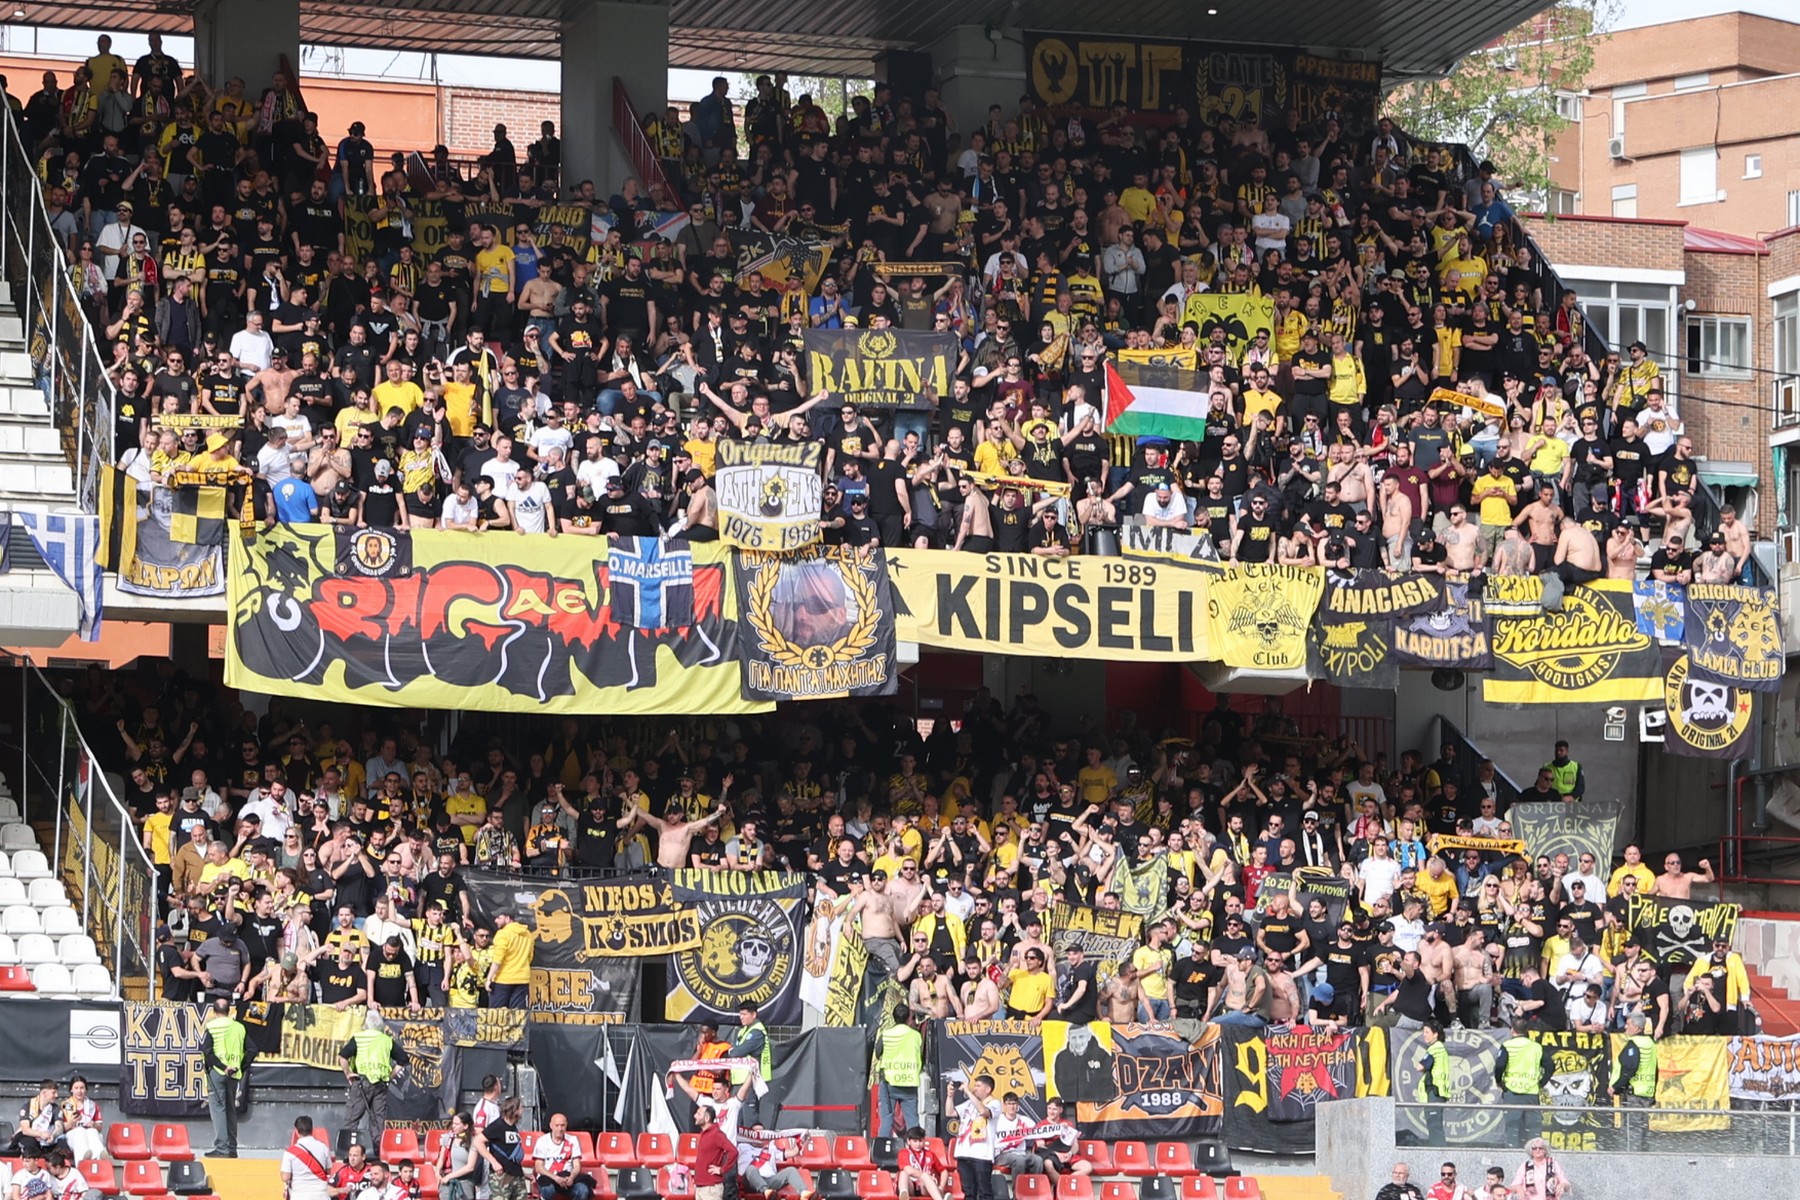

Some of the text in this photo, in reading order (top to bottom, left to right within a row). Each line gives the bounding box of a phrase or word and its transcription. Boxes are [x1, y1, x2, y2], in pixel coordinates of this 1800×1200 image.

[810, 350, 948, 397] RAFINA
[844, 392, 915, 405] ORIGINAL 21
[718, 437, 802, 468] Original
[985, 554, 1157, 587] SINCE 1989
[1328, 577, 1439, 614] ANACASA
[1688, 583, 1763, 605] ORIGINAL
[936, 573, 1194, 653] KIPSELI
[1253, 651, 1289, 665] Club
[1394, 626, 1489, 661] KARDITSA
[1535, 657, 1611, 688] HOOLIGANS
[1691, 648, 1780, 680] LAMIA CLUB
[1681, 724, 1727, 748] ORIGINAL
[1519, 802, 1618, 815] ORIGINAL
[584, 884, 657, 913] NEOS
[528, 968, 594, 1011] REE
[1141, 1092, 1182, 1107] 1988
